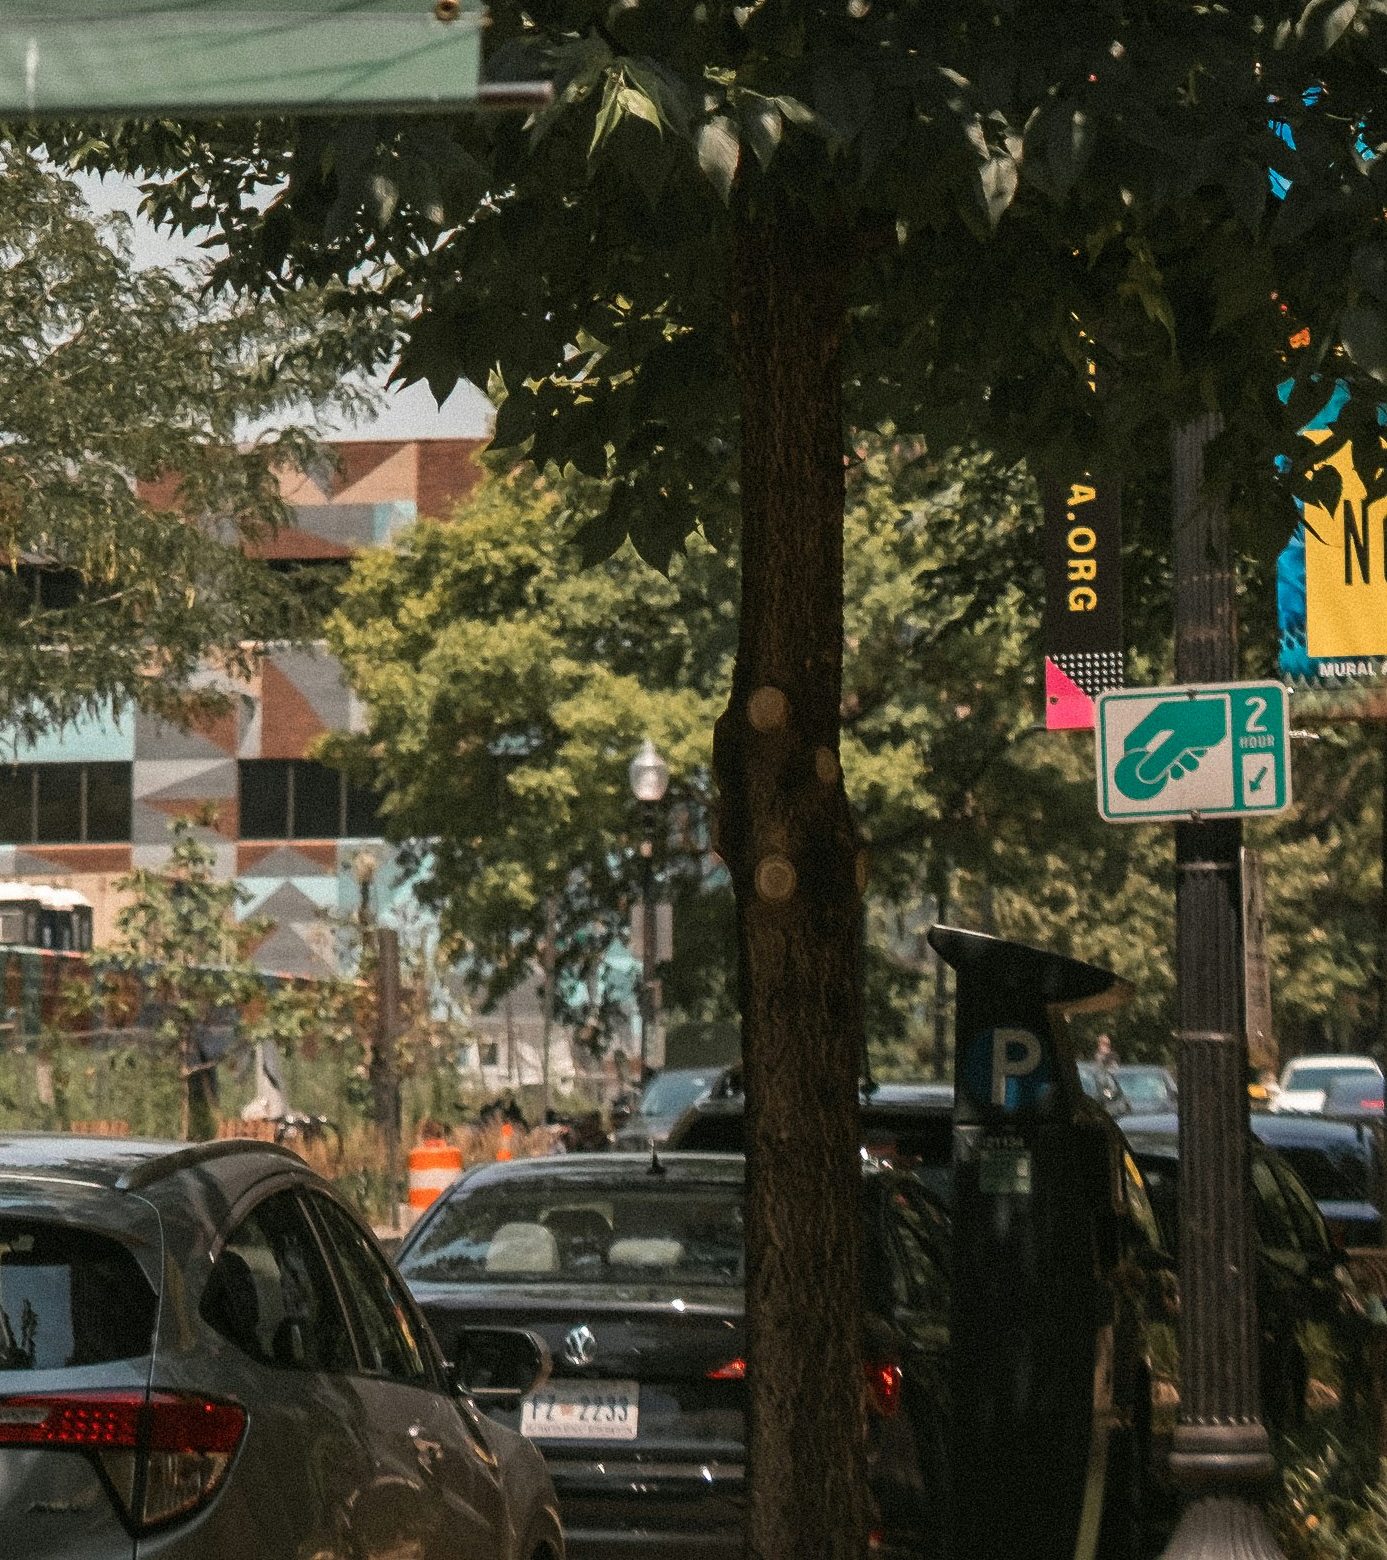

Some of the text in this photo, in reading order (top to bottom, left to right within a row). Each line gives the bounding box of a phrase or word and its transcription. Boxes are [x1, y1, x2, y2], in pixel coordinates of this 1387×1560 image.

[1343, 498, 1387, 586] N
[1319, 662, 1376, 678] MURAL
[1245, 696, 1268, 733] 2
[1239, 734, 1275, 749] HOUR
[991, 1028, 1042, 1106] P
